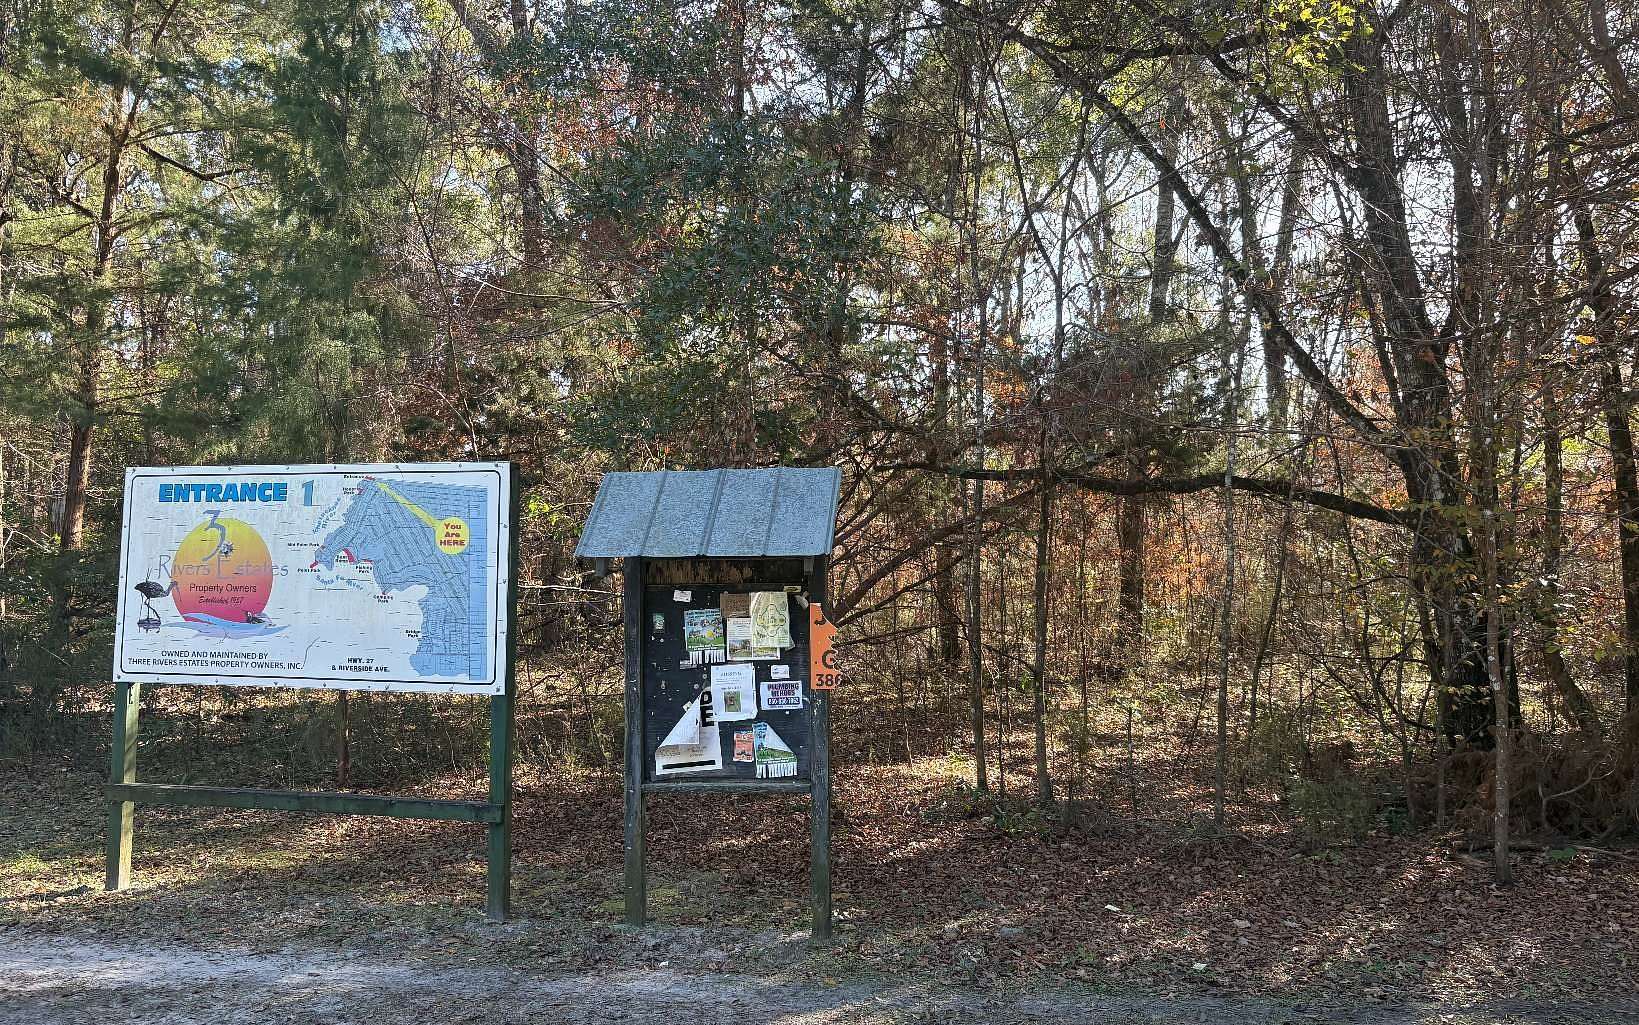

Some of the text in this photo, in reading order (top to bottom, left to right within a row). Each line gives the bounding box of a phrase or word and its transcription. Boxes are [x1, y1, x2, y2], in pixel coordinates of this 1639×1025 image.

[158, 479, 315, 507] ENTRANCE 1
[443, 522, 462, 530] You
[202, 509, 226, 562] 3
[157, 553, 289, 580] Rivers Estates
[189, 583, 257, 594] Property Owners
[161, 650, 190, 658] OWNED
[209, 651, 257, 660] MAINTAINED
[258, 652, 269, 660] BY
[128, 657, 304, 670] THREE RIVERS ESTATES PROPERTY OWNERS, INC.
[338, 665, 374, 673] RIVERSIDE
